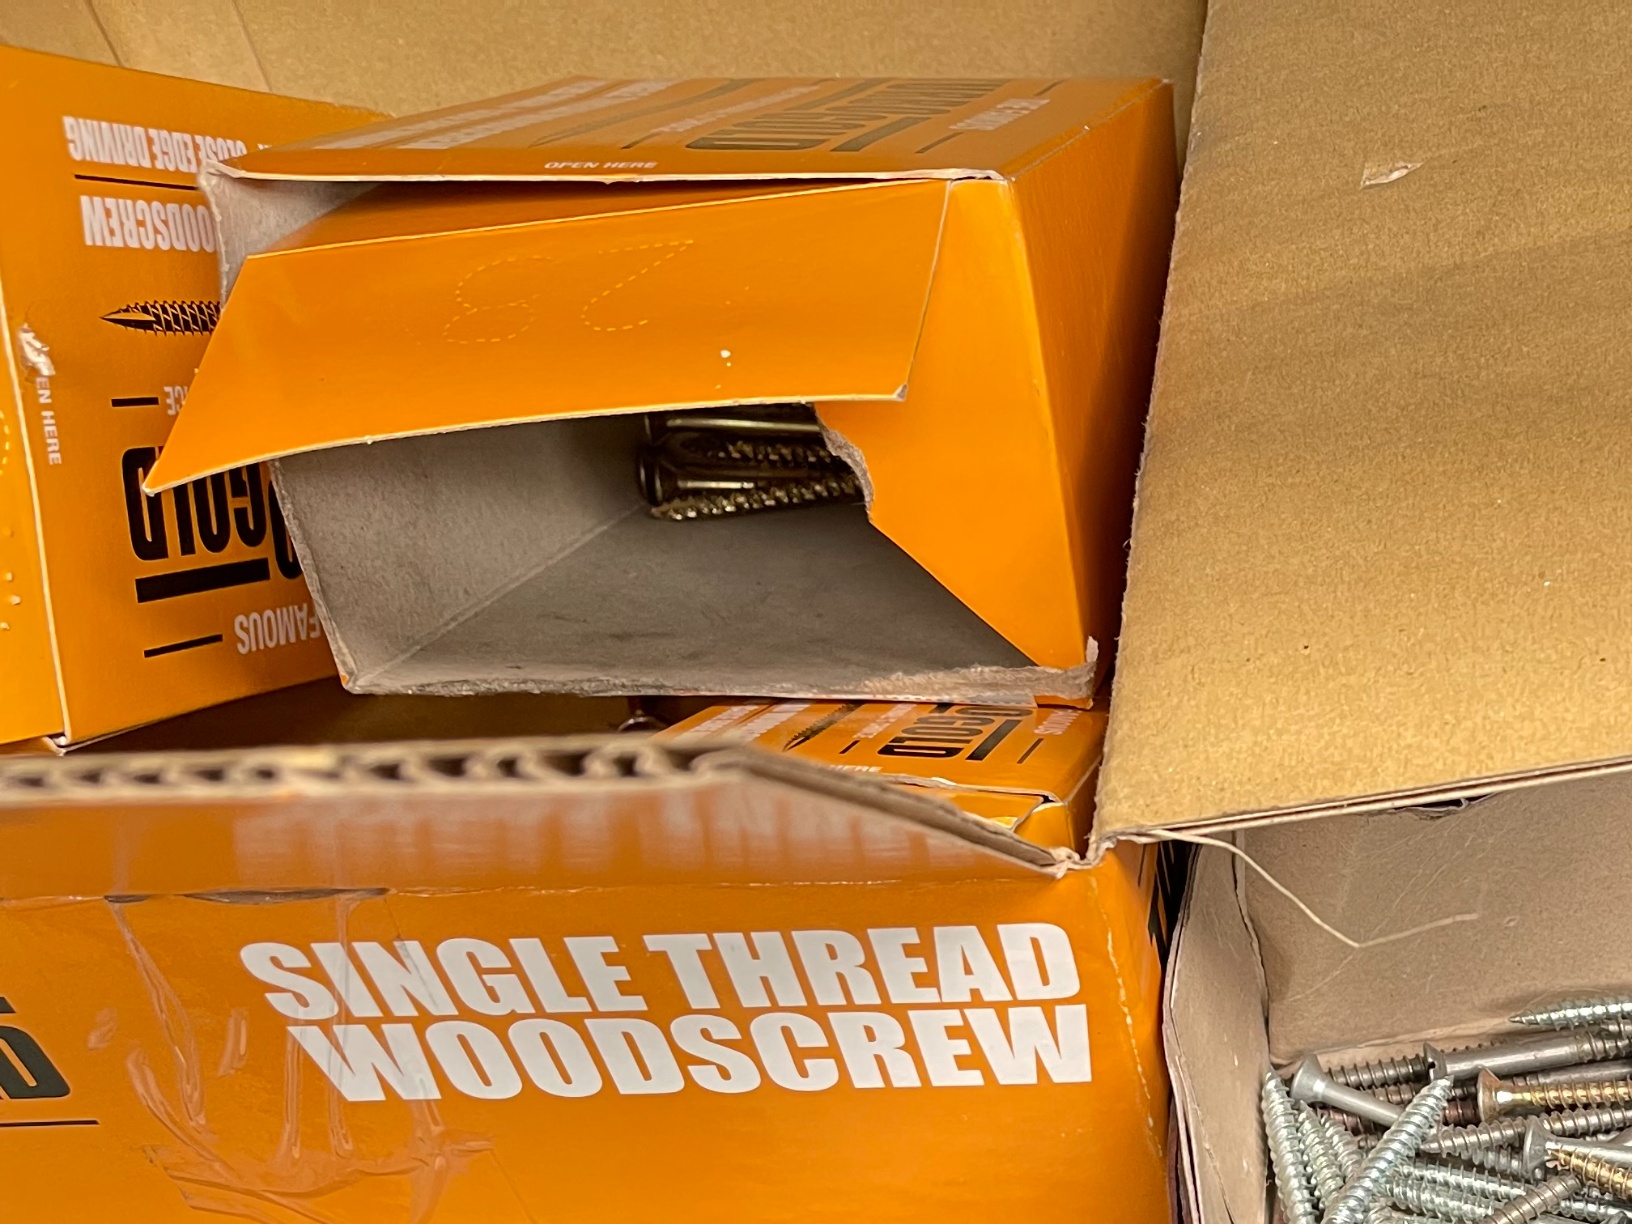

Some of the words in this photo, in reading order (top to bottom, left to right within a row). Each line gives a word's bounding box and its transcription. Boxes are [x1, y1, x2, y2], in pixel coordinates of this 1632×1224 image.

[62, 115, 152, 169] DRIVING
[148, 127, 198, 174] EDGE
[544, 161, 600, 169] OPEN
[603, 161, 658, 169] HERE
[80, 194, 218, 253] OODSCREW
[41, 410, 62, 466] HERE
[238, 934, 650, 1021] SINGLE
[645, 921, 1083, 1012] THREAD
[285, 1002, 1095, 1103] WOODSCREW
